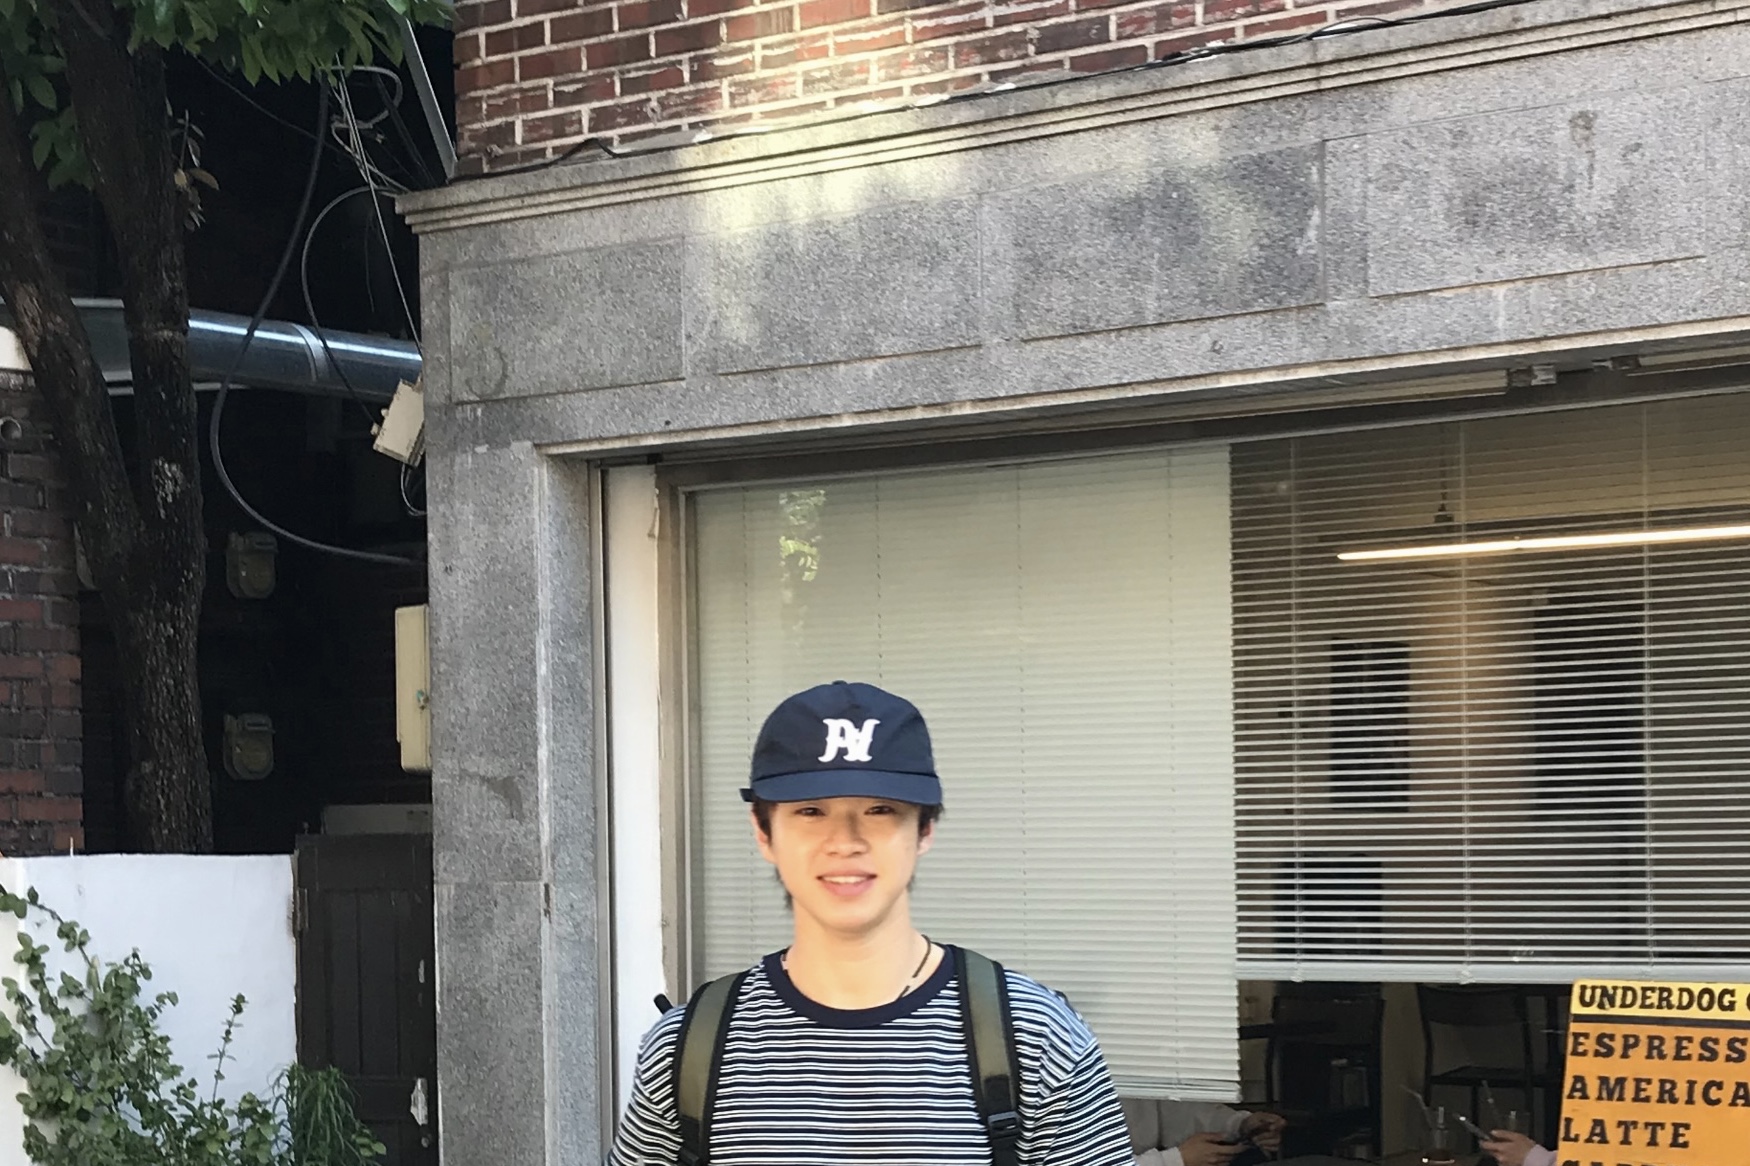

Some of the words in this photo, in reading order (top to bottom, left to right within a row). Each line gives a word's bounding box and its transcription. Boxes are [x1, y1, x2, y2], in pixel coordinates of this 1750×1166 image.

[1578, 984, 1737, 1012] UNDERDOG
[1569, 1031, 1749, 1064] ESPRESS
[1566, 1074, 1750, 1108] AMERICA
[1561, 1116, 1691, 1149] LATTE
